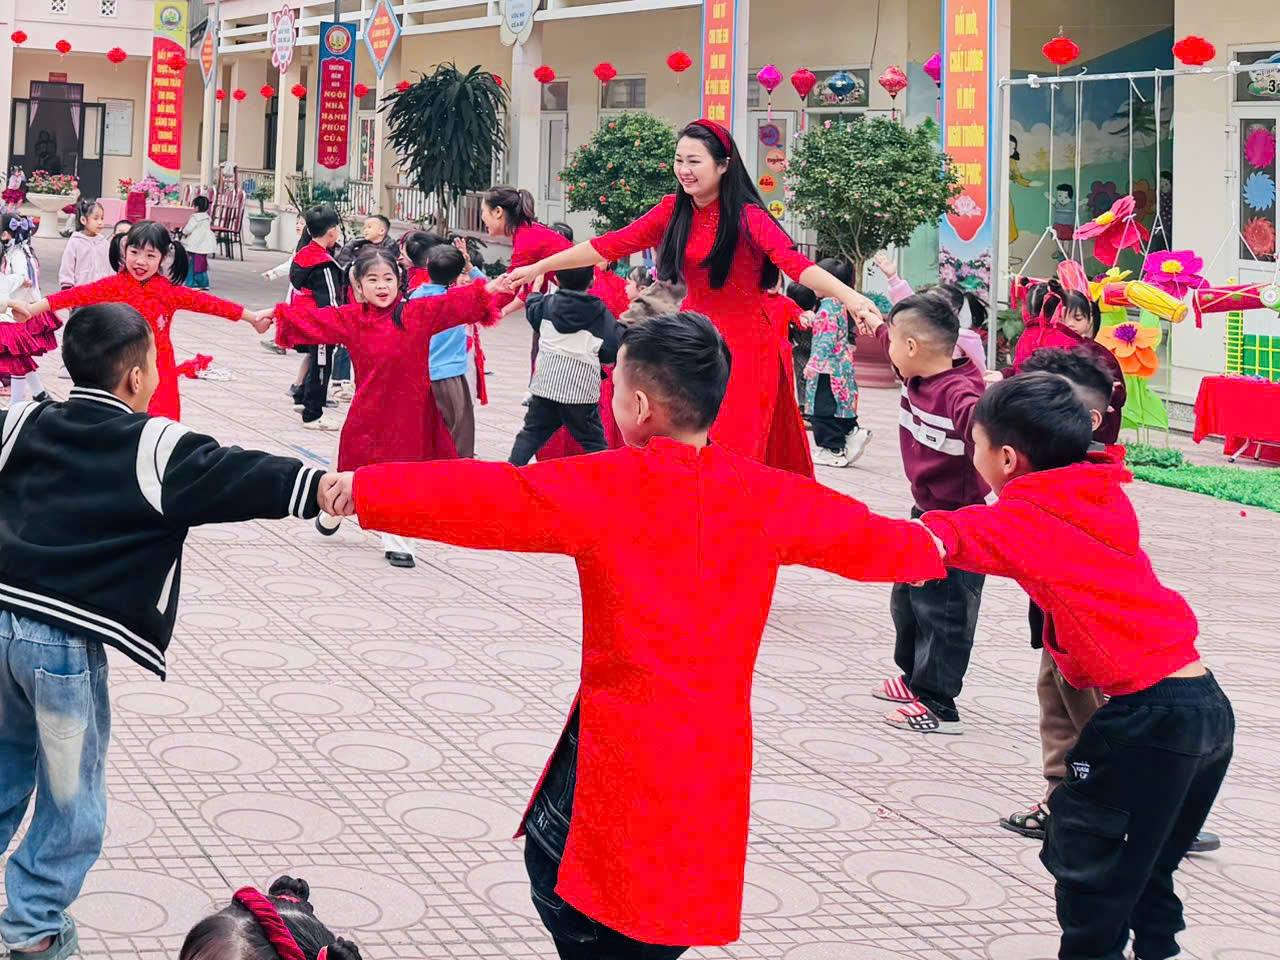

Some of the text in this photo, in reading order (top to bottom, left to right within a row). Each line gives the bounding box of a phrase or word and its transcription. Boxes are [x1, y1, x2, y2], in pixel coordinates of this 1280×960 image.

[323, 90, 346, 98] NGÔI
[325, 100, 344, 109] NHÀ
[321, 113, 347, 121] HẠNH
[321, 122, 345, 131] PHÚC
[323, 133, 342, 142] CỦA
